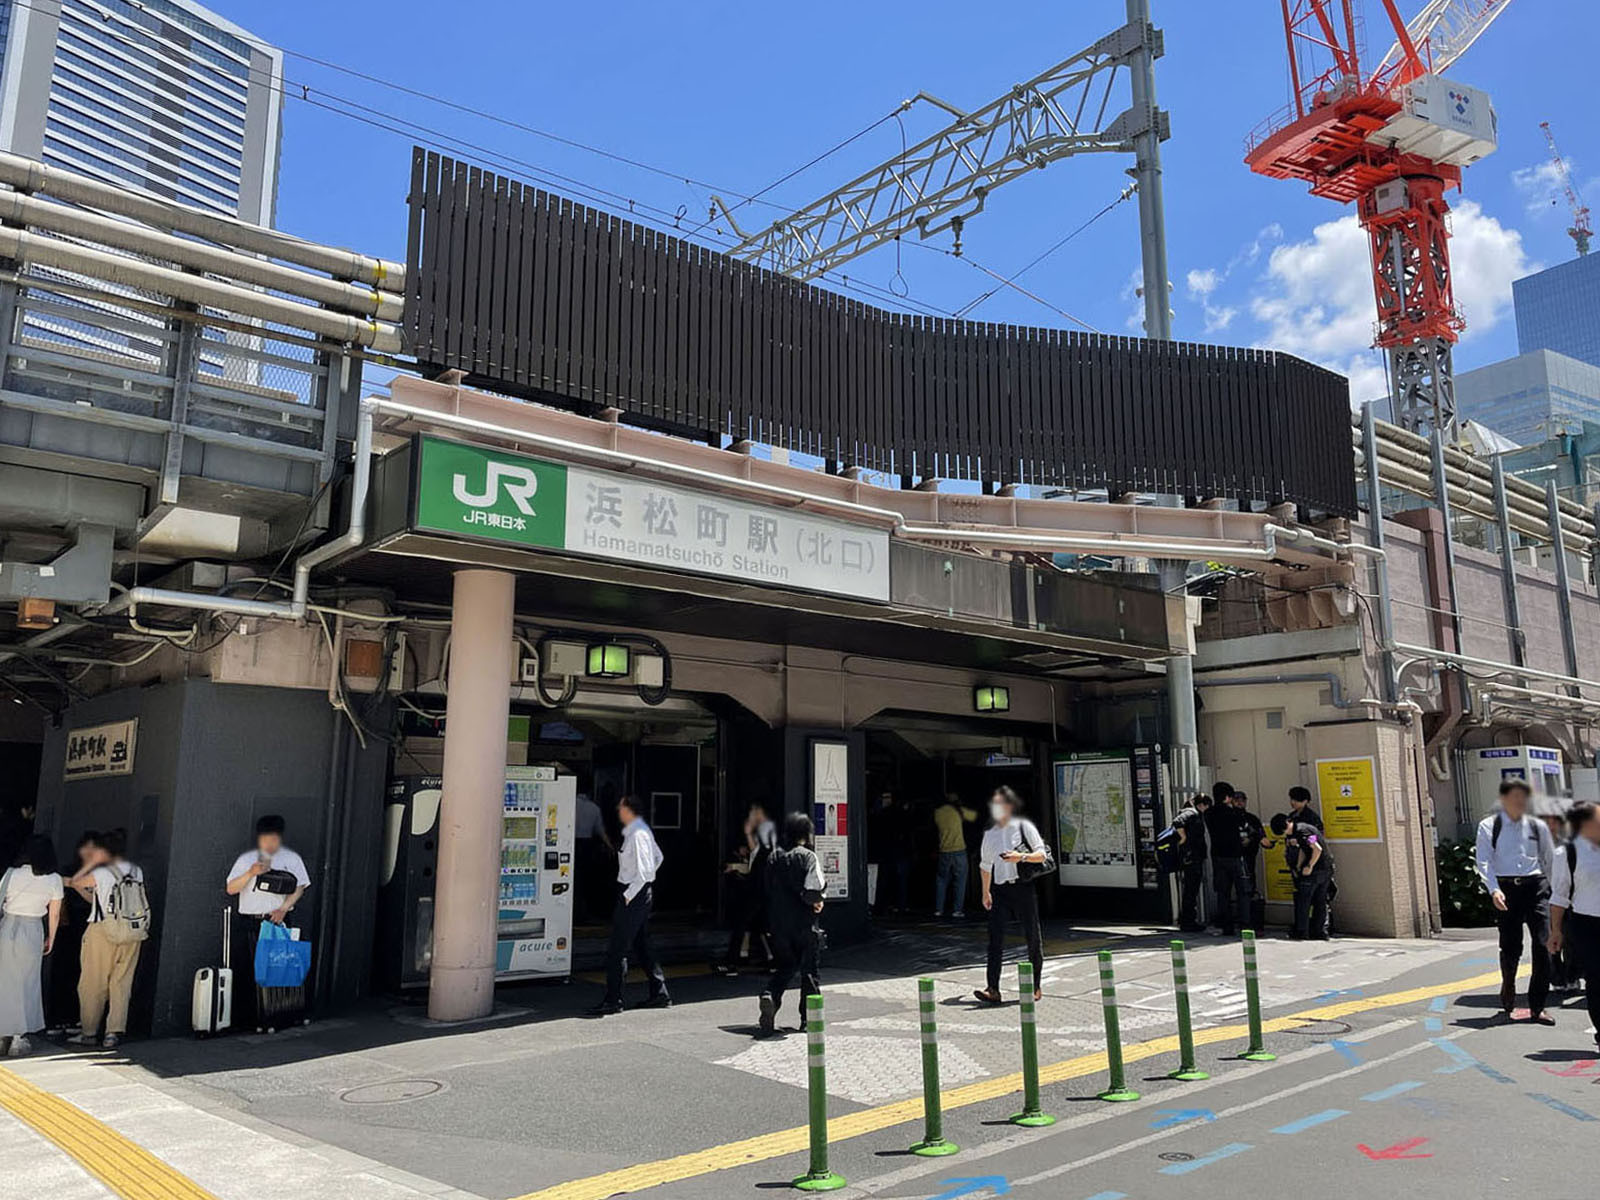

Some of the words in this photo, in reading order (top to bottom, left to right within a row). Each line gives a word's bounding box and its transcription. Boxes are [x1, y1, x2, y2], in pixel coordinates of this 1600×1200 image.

[452, 460, 538, 517] JR
[463, 509, 527, 531] JR東日本
[732, 554, 789, 579] Station
[519, 941, 553, 953] acure
